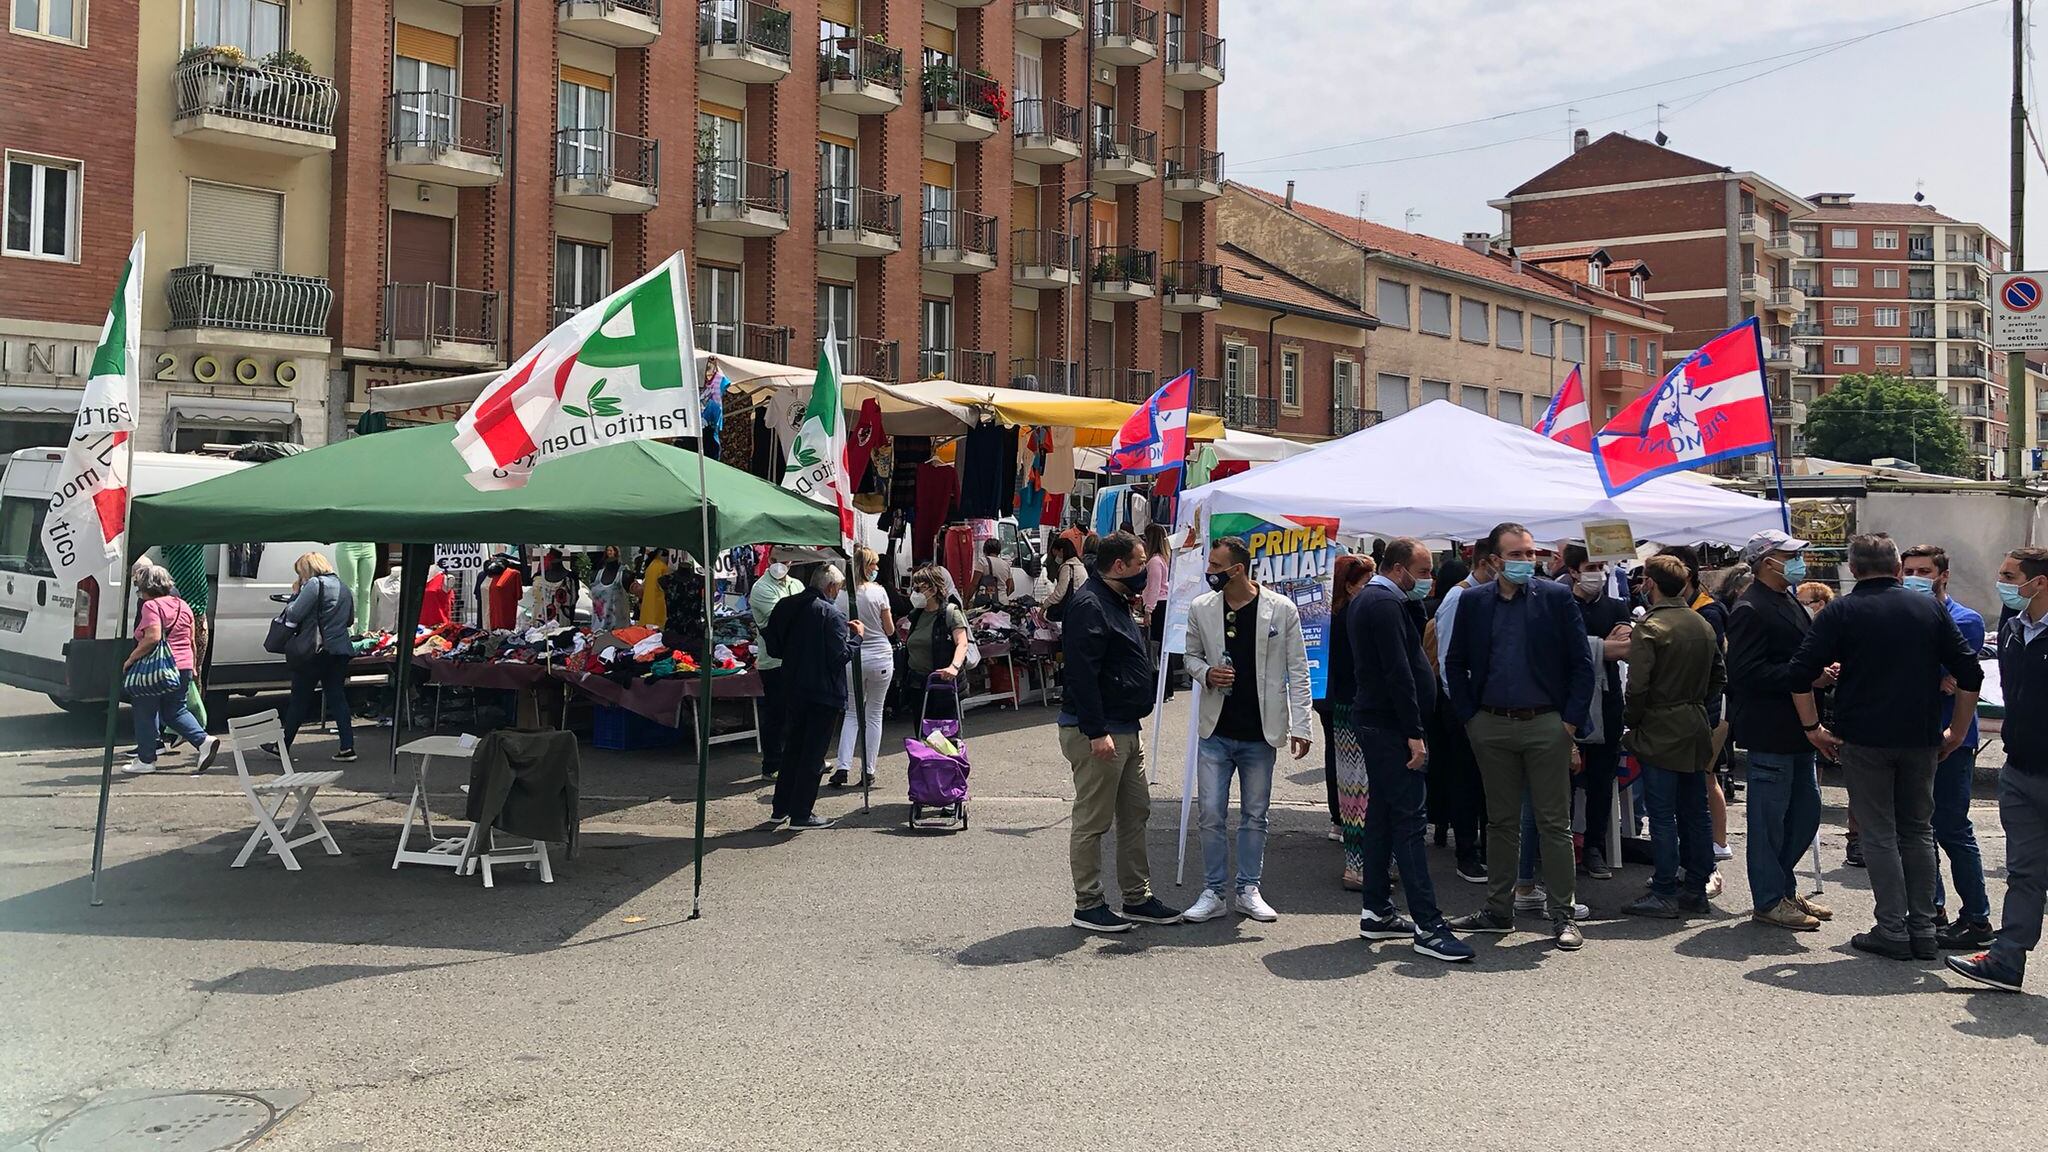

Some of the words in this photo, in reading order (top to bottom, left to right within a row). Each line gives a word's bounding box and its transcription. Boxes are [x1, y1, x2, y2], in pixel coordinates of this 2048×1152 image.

[154, 352, 298, 389] 2000
[1249, 525, 1327, 558] PRIMA
[1248, 549, 1327, 585] TALIA!
